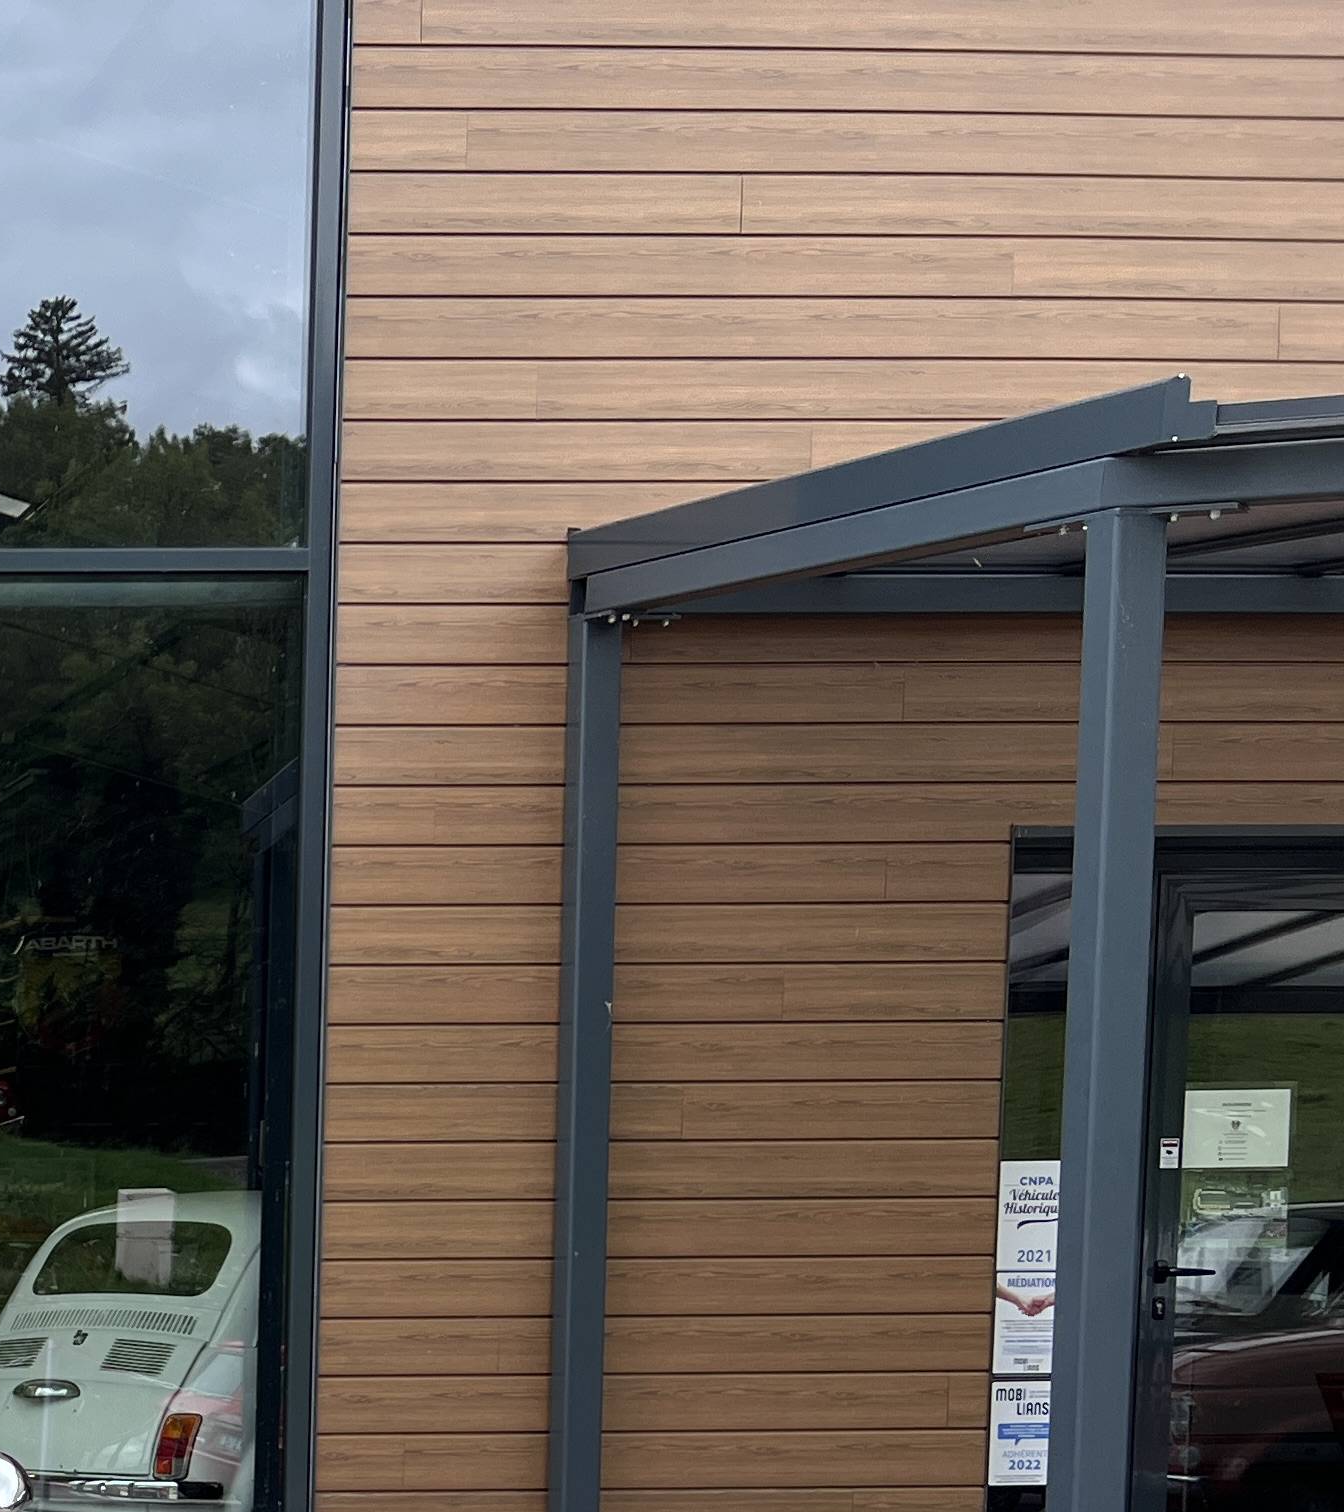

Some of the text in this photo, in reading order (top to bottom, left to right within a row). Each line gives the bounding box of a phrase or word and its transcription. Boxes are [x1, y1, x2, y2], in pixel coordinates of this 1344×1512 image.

[1020, 1176, 1053, 1186] CNPA
[1004, 1202, 1059, 1216] Historiqu
[1017, 1250, 1051, 1262] 2021
[1008, 1460, 1041, 1470] 2022
